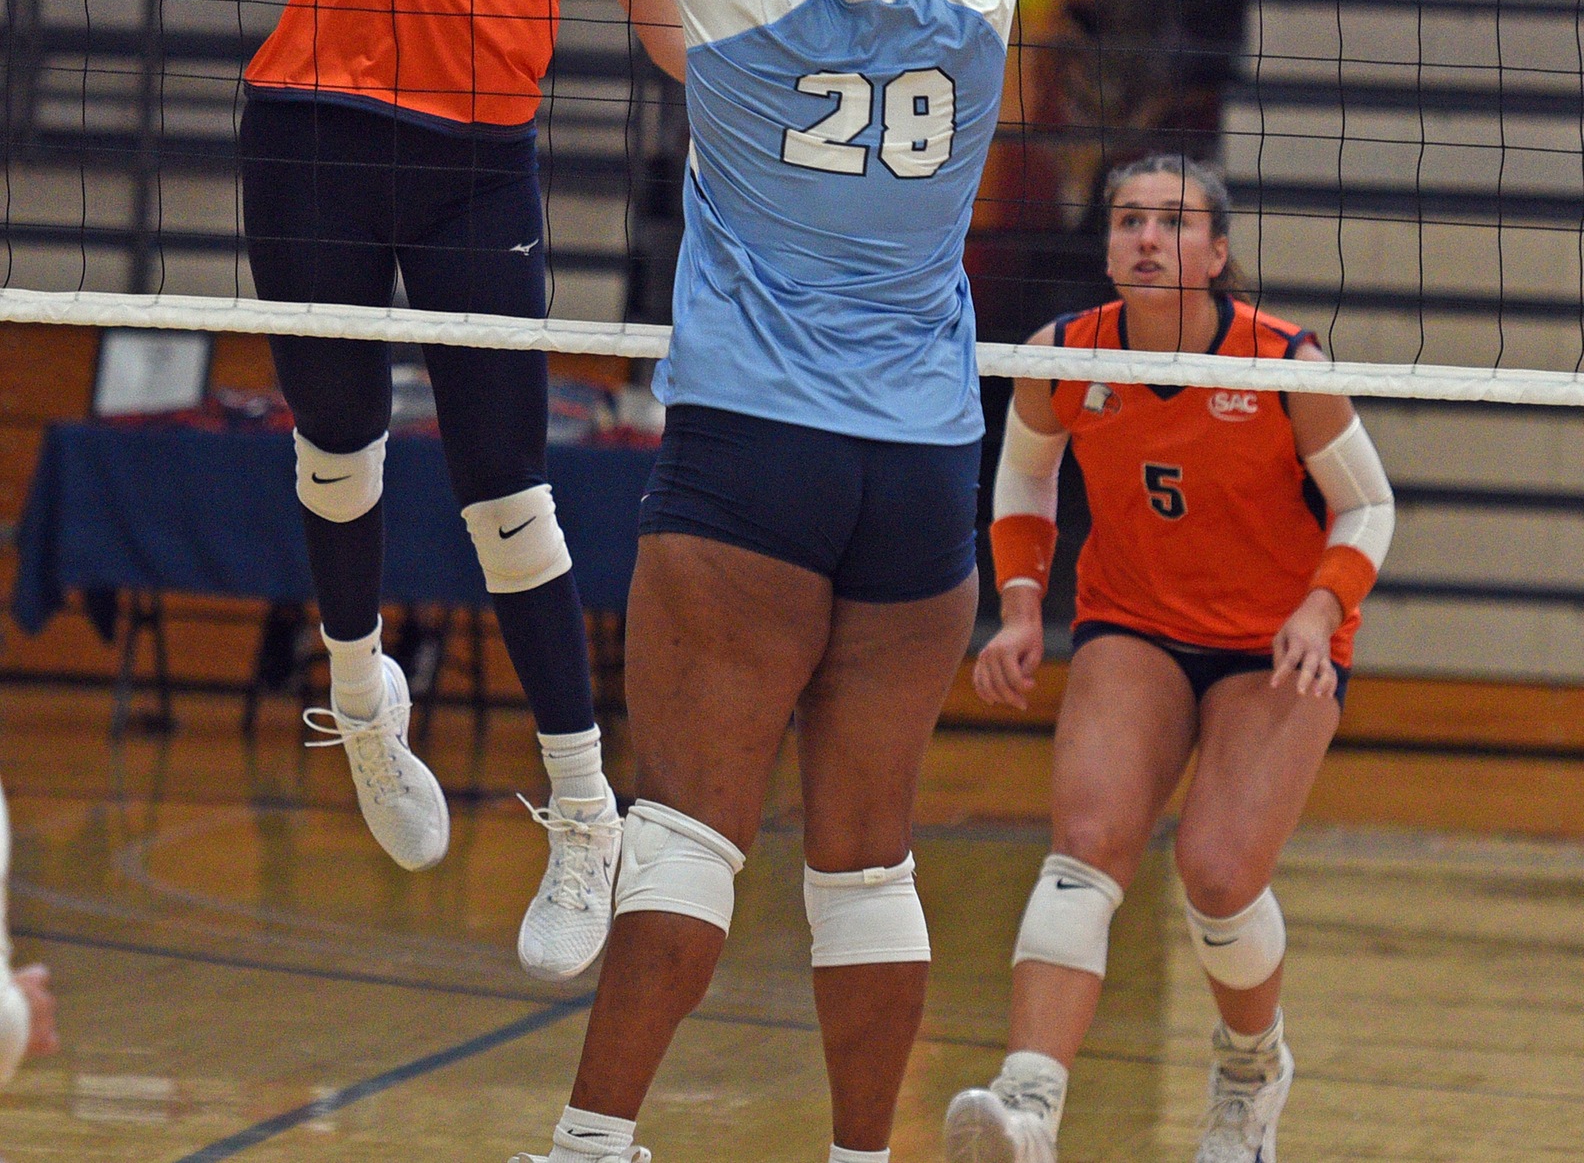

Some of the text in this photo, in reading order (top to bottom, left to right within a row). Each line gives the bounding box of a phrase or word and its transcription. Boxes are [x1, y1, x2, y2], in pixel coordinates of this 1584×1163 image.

[781, 67, 956, 179] 28
[1214, 391, 1258, 414] SAC
[1143, 462, 1188, 520] 5
